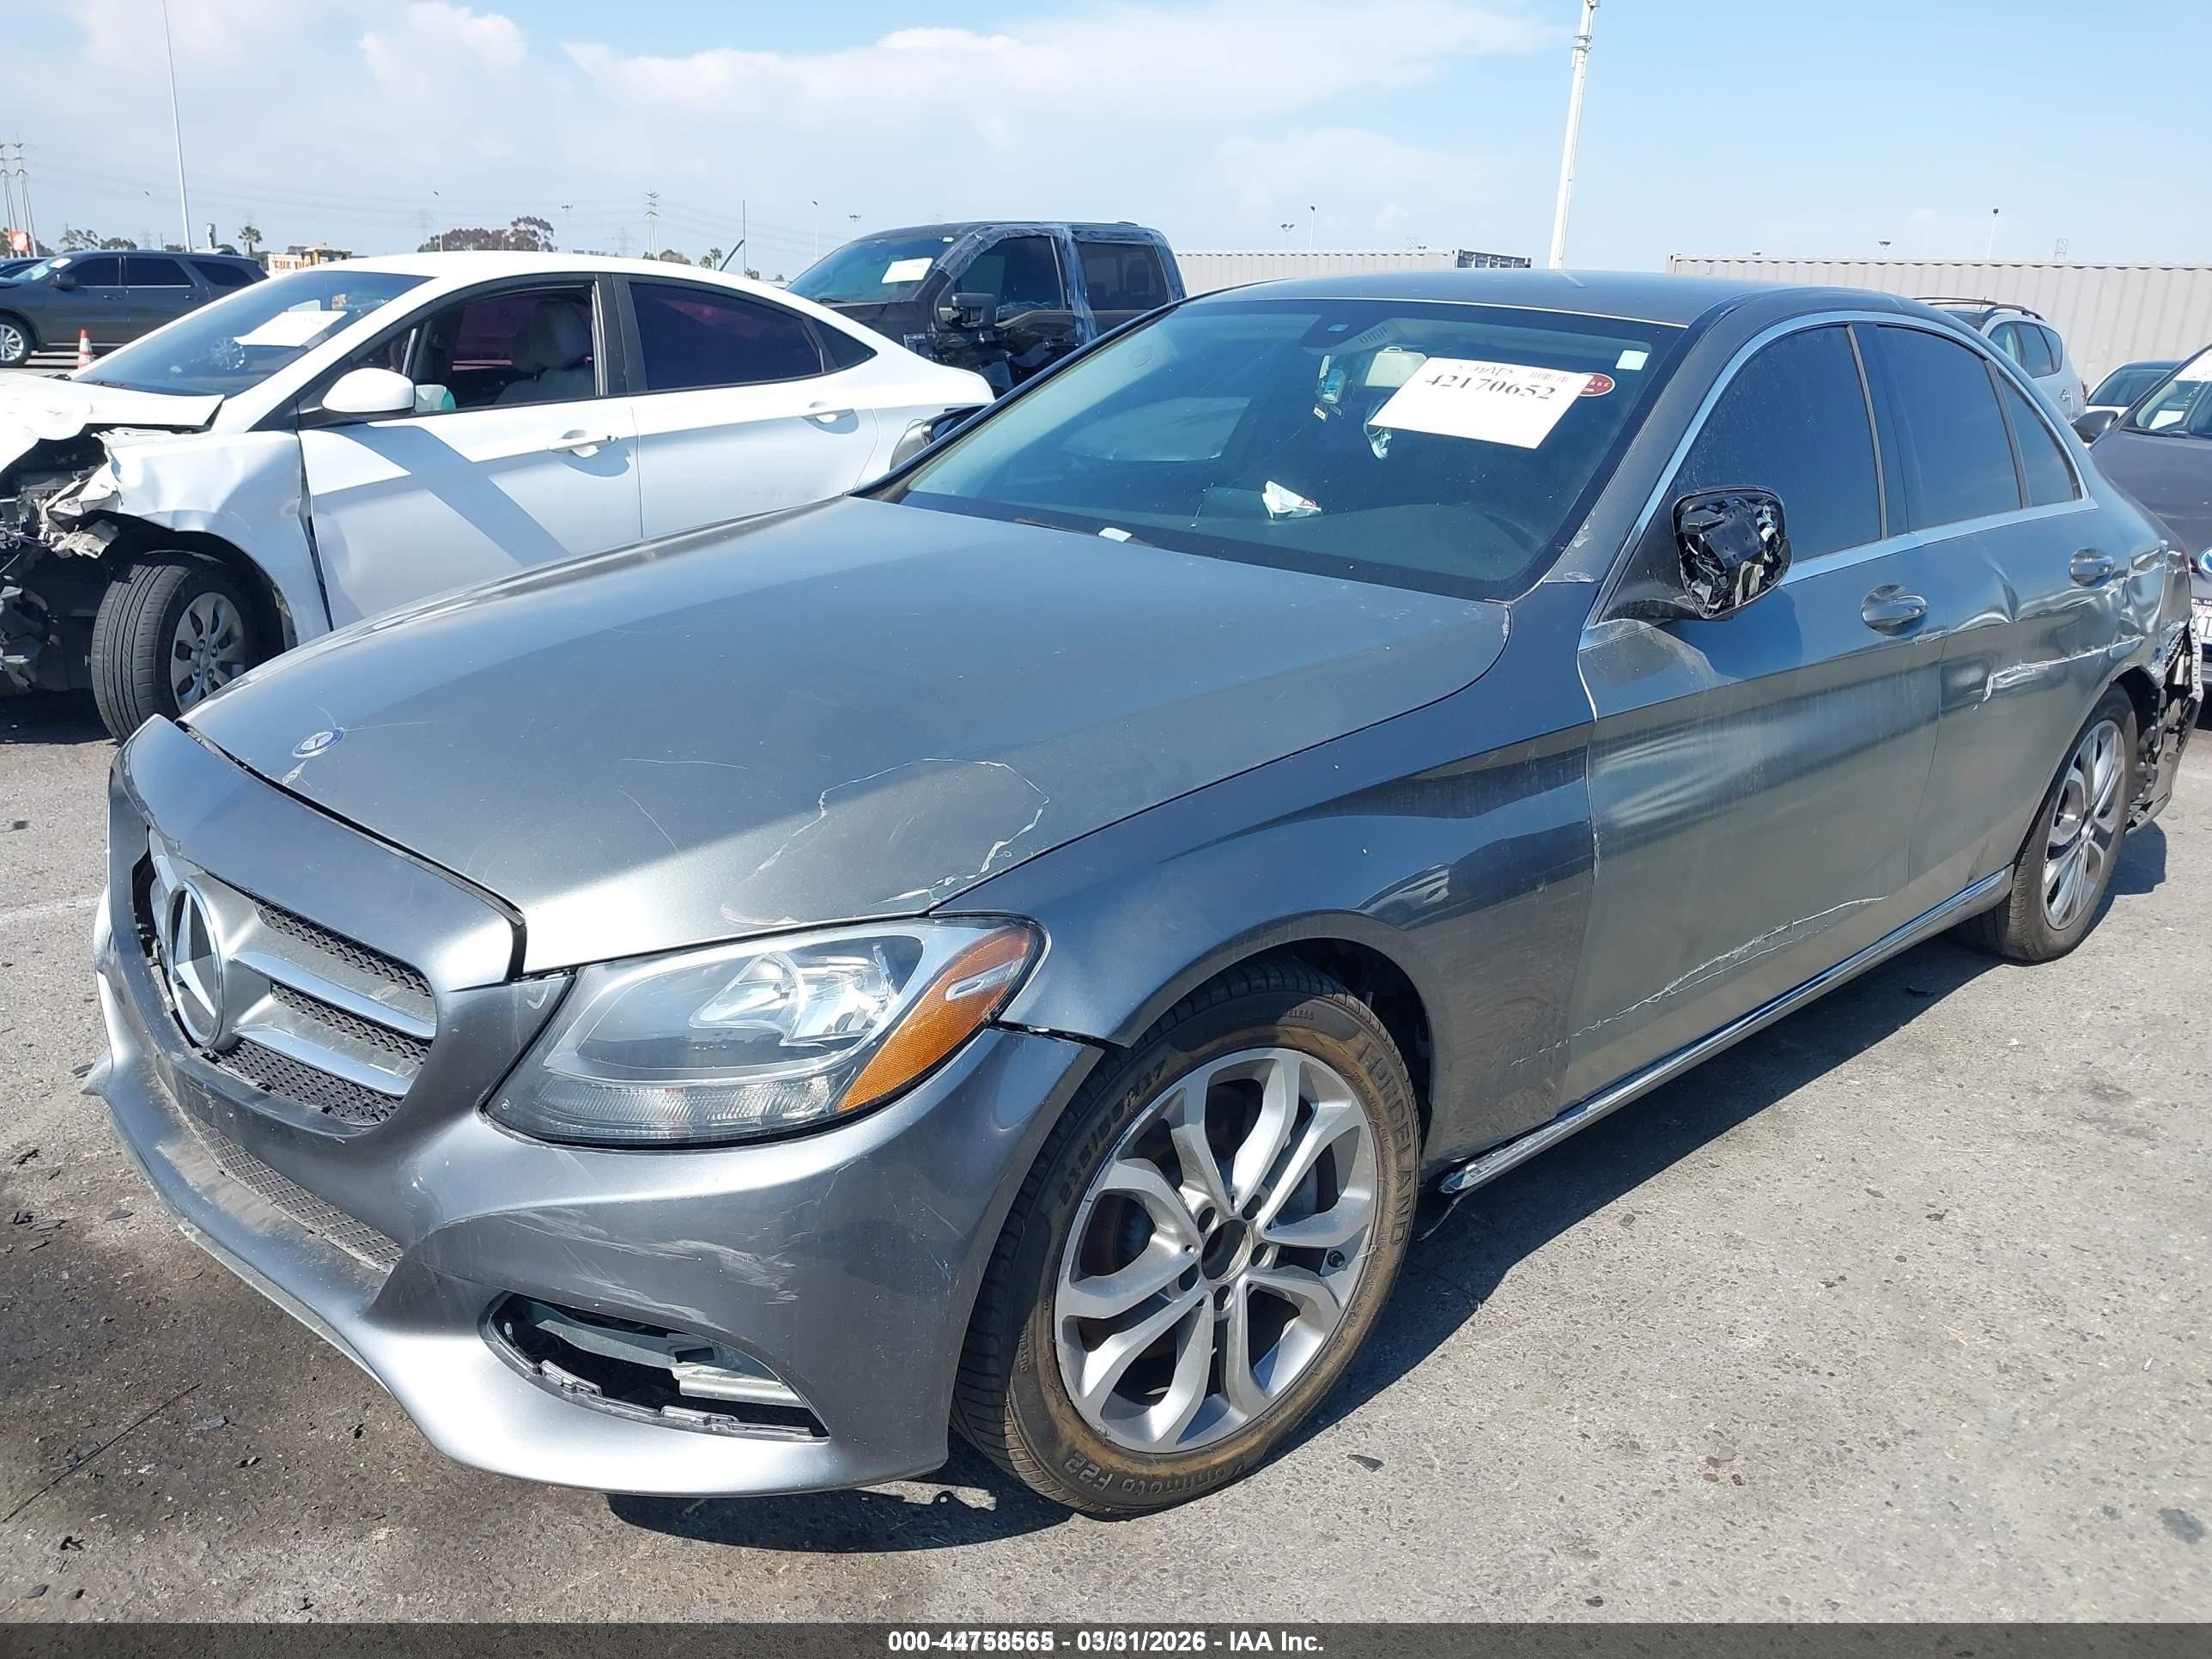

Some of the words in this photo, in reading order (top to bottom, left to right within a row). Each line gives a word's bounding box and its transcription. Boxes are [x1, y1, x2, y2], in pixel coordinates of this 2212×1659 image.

[1425, 374, 1556, 400] 42170652
[1358, 1042, 1413, 1245] FORCELAND
[1061, 1449, 1115, 1492] F22
